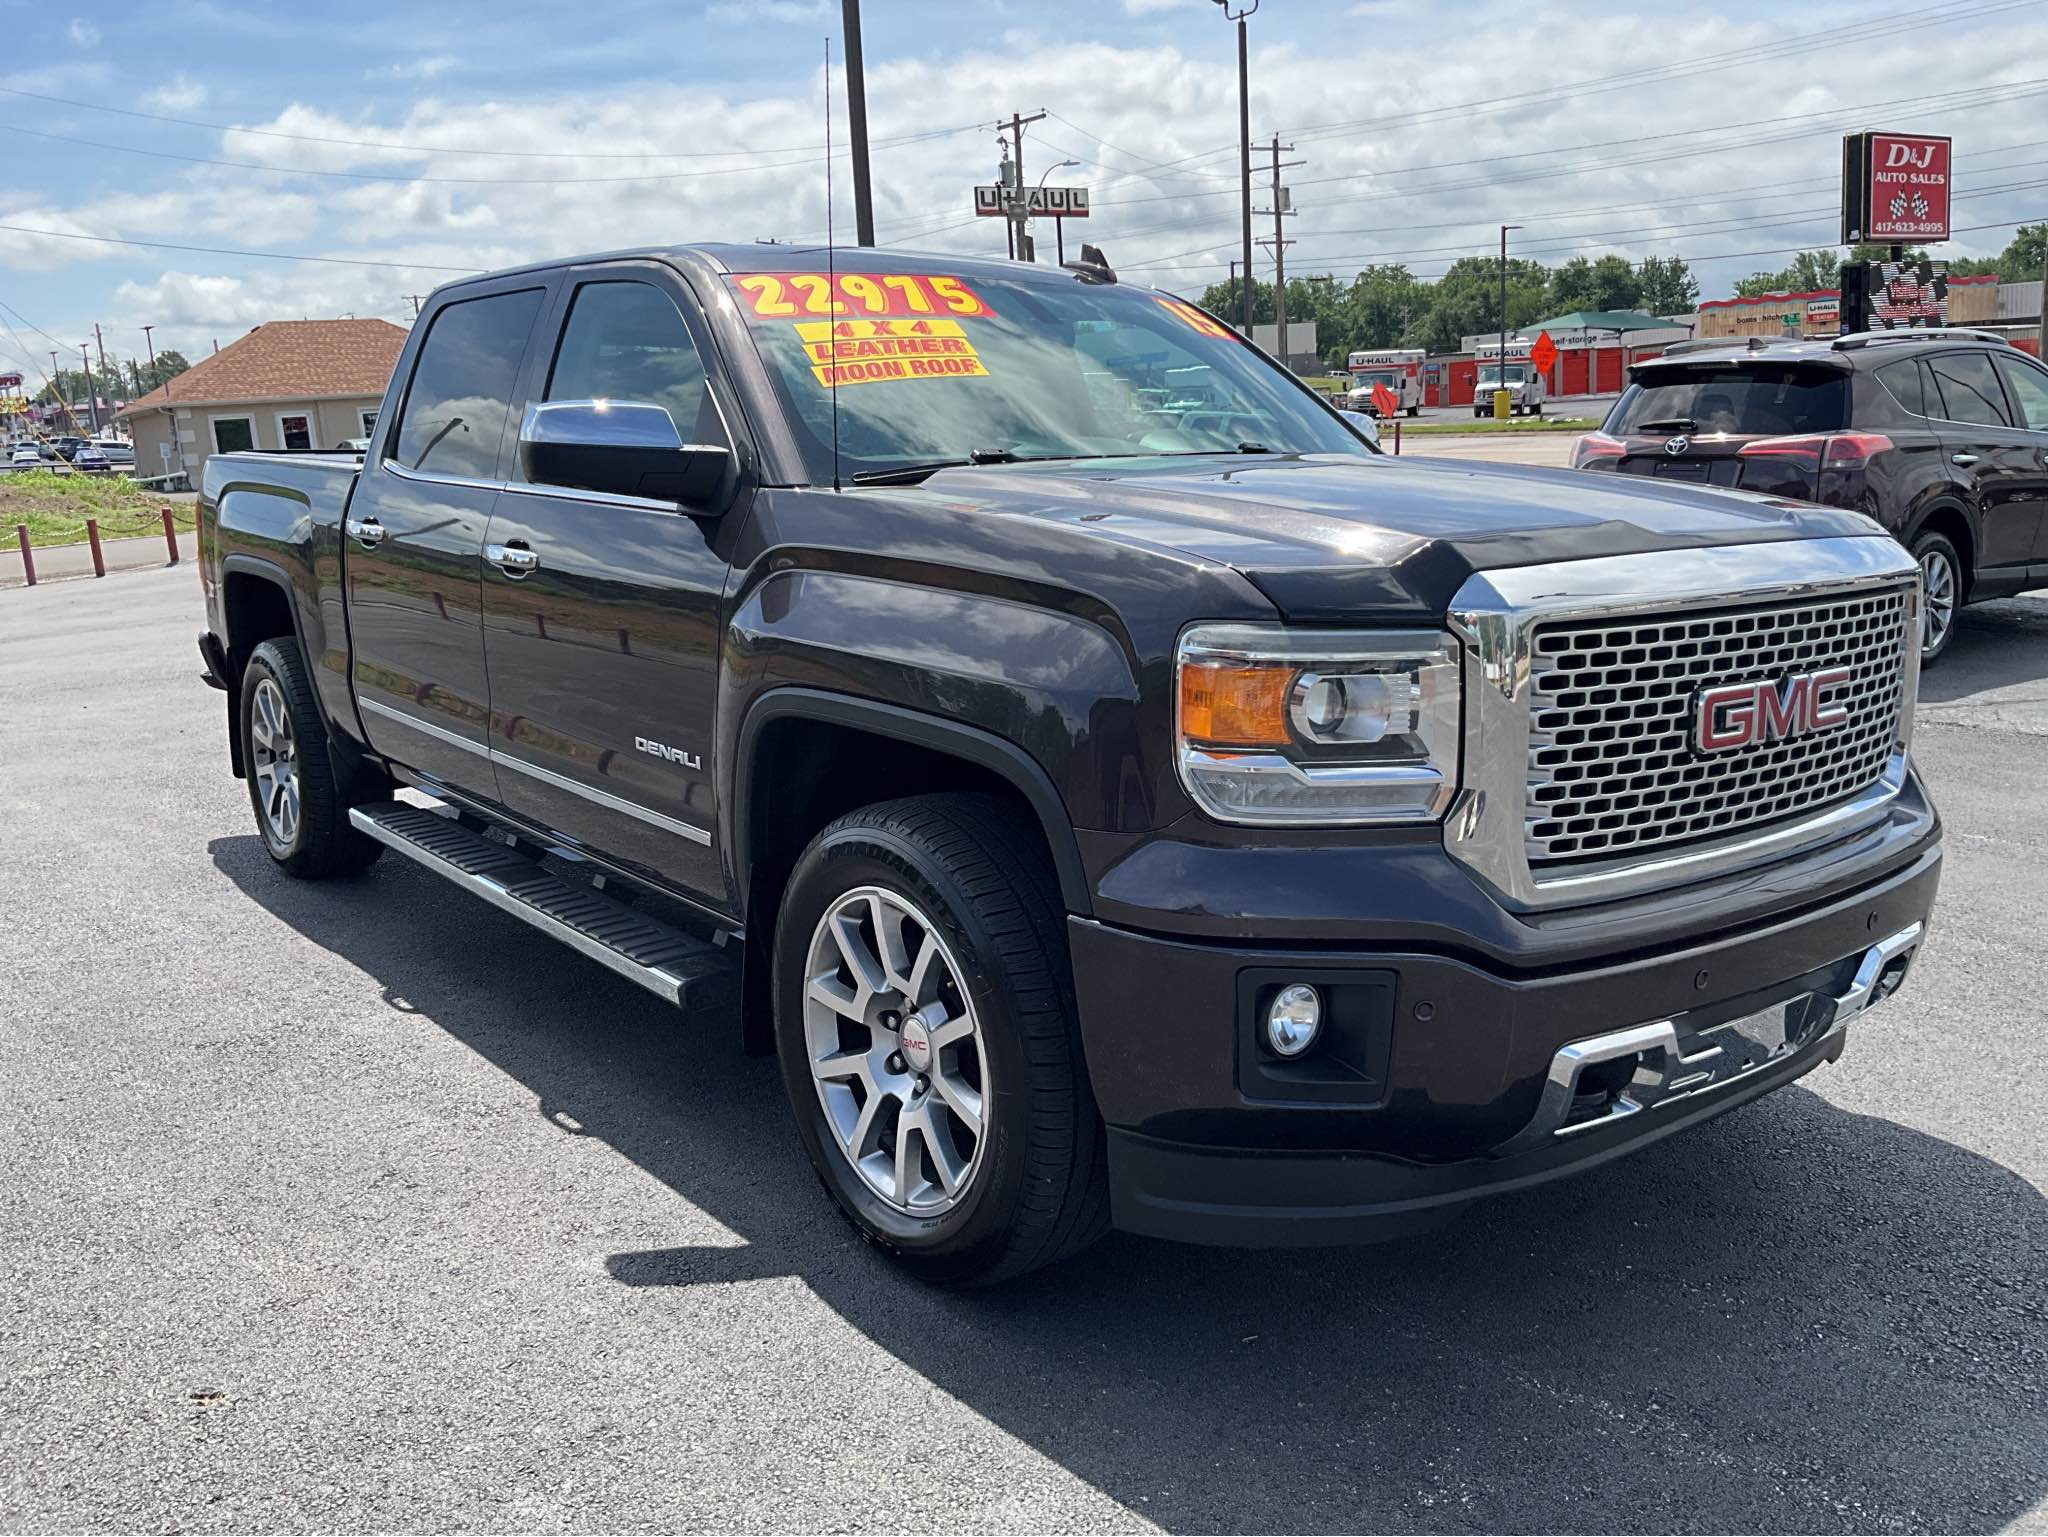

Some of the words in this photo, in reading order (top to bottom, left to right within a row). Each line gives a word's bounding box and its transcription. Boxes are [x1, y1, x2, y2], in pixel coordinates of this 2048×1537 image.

[1885, 143, 1936, 169] D&J
[1875, 172, 1908, 184] AUTO
[1909, 173, 1945, 185] SALES
[1875, 221, 1944, 233] 417-623-4995
[739, 275, 983, 315] 22975
[1157, 299, 1226, 337] 15
[1809, 303, 1838, 312] U-HAUL
[834, 321, 854, 338] 4
[872, 320, 896, 336] X
[910, 319, 932, 335] 4
[815, 338, 968, 360] LEATHER
[822, 360, 907, 384] MOON
[910, 357, 978, 376] ROOF
[1356, 357, 1394, 365] U-HAUL
[1696, 665, 1850, 752] GMC
[634, 736, 702, 770] DENALI
[902, 1038, 928, 1051] GMC
